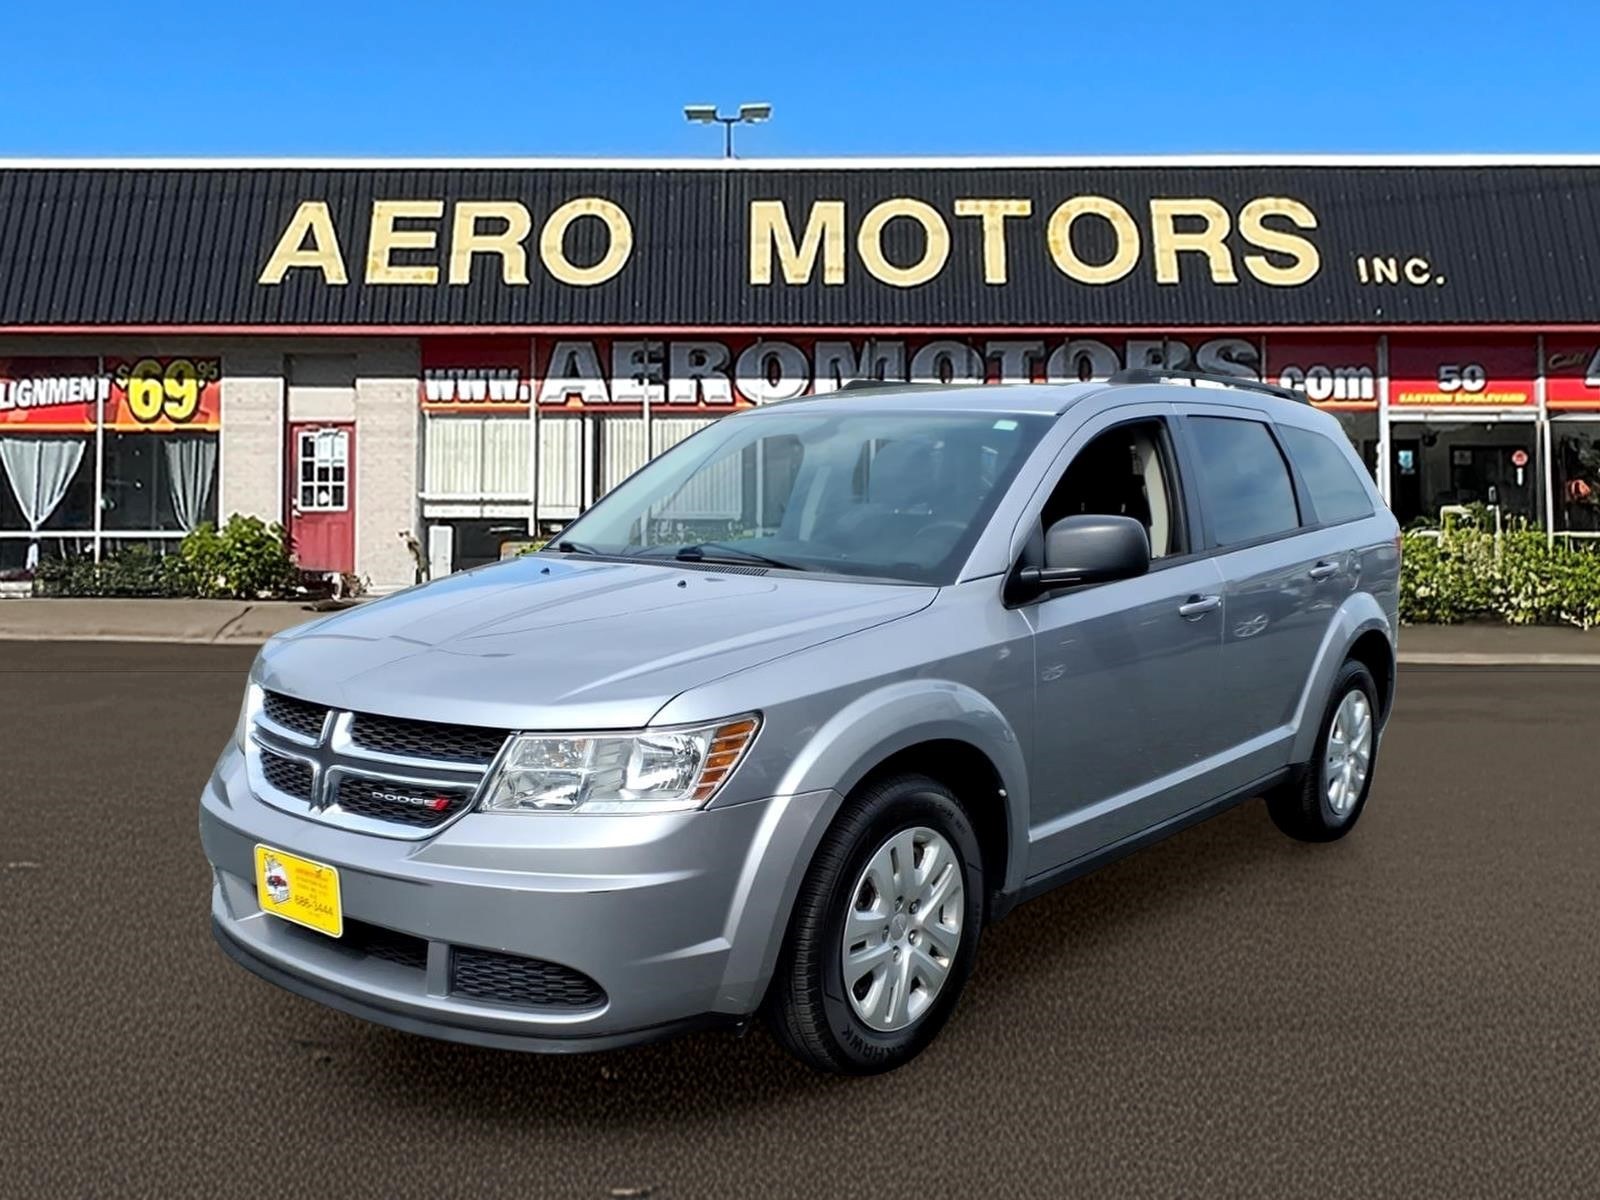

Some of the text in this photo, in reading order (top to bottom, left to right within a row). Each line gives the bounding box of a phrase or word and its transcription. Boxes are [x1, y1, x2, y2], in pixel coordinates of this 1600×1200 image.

[258, 195, 1446, 287] AERO MOTORS INC.
[1438, 364, 1486, 392] 50
[372, 791, 437, 807] DODGE
